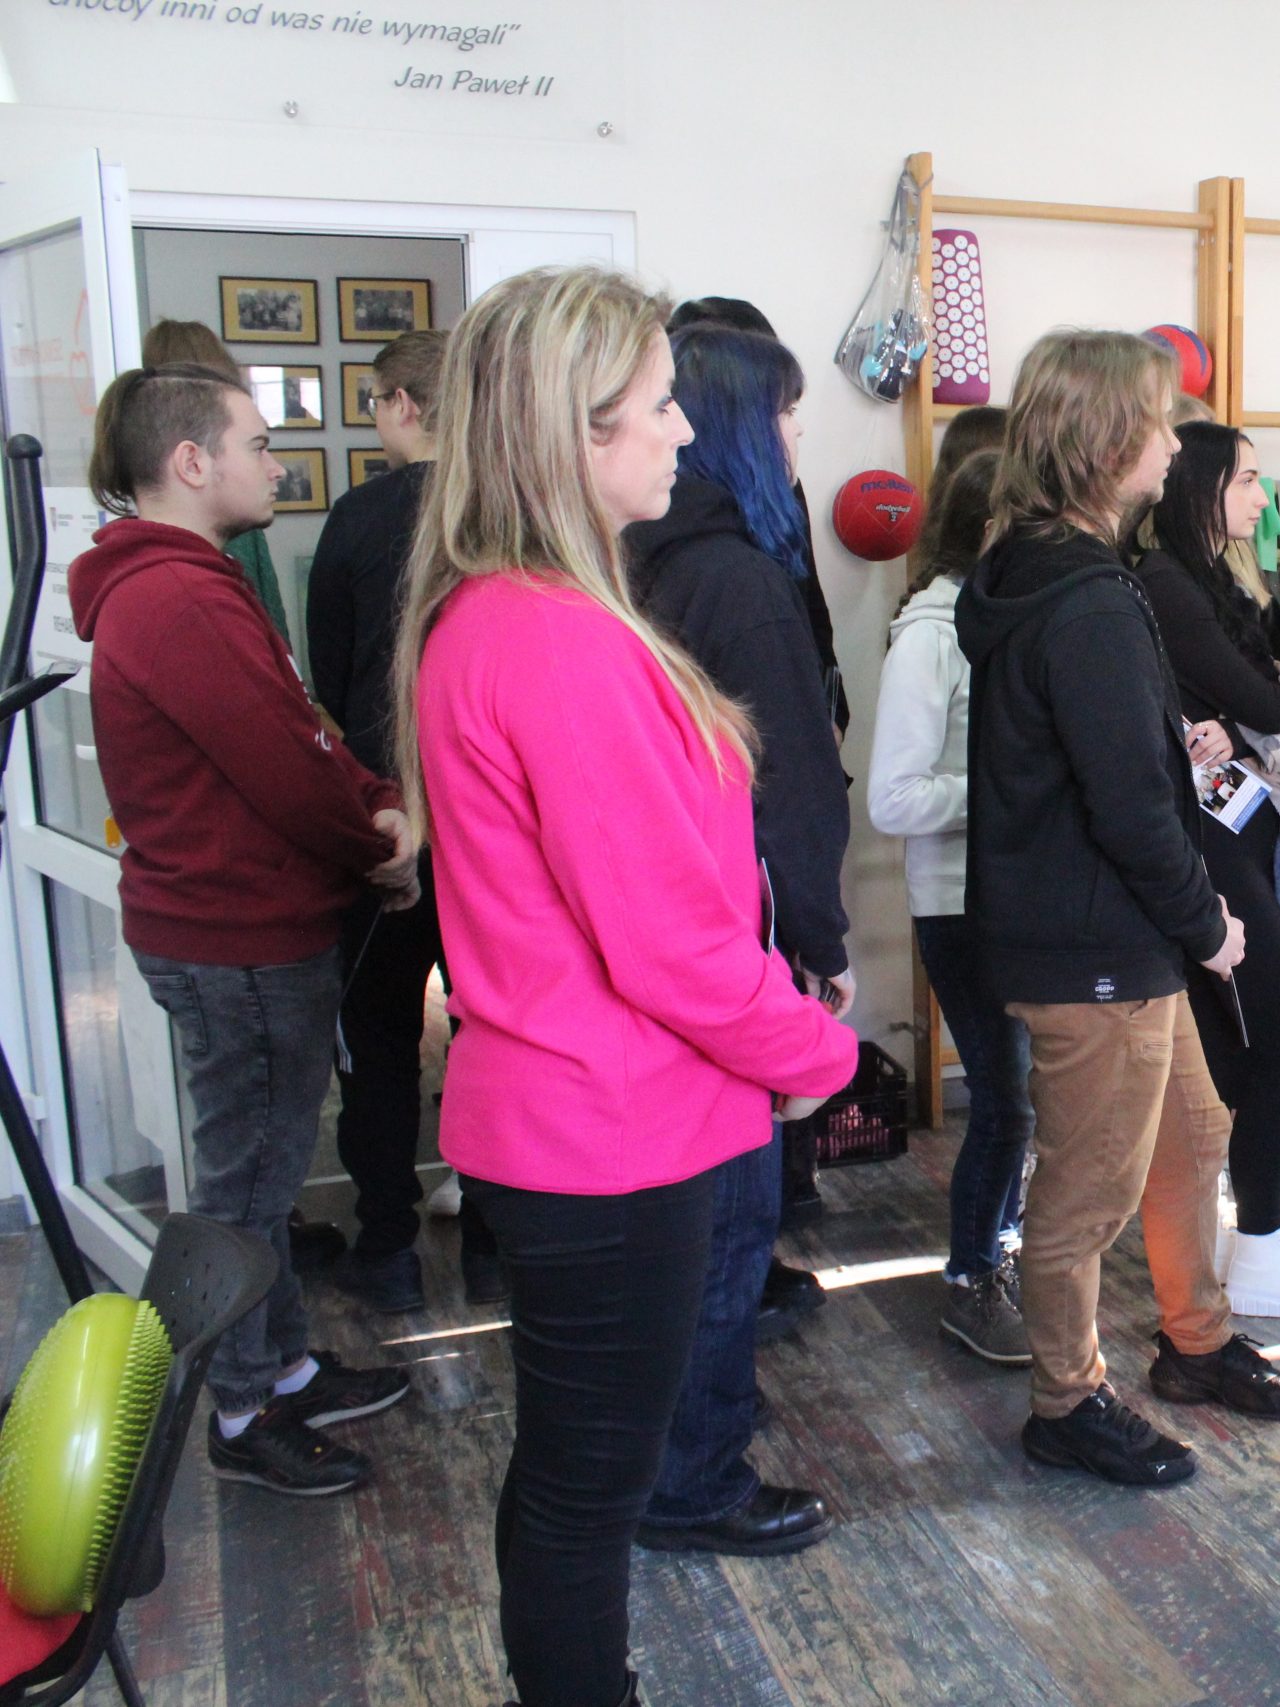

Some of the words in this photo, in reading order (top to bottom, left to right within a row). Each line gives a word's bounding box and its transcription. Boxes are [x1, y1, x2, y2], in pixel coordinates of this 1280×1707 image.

[160, 0, 217, 20] inni
[226, 3, 263, 24] od
[270, 10, 323, 30] was
[332, 11, 373, 35] nie
[394, 66, 443, 90] Jan
[452, 70, 529, 96] Paweł
[534, 76, 554, 96] II
